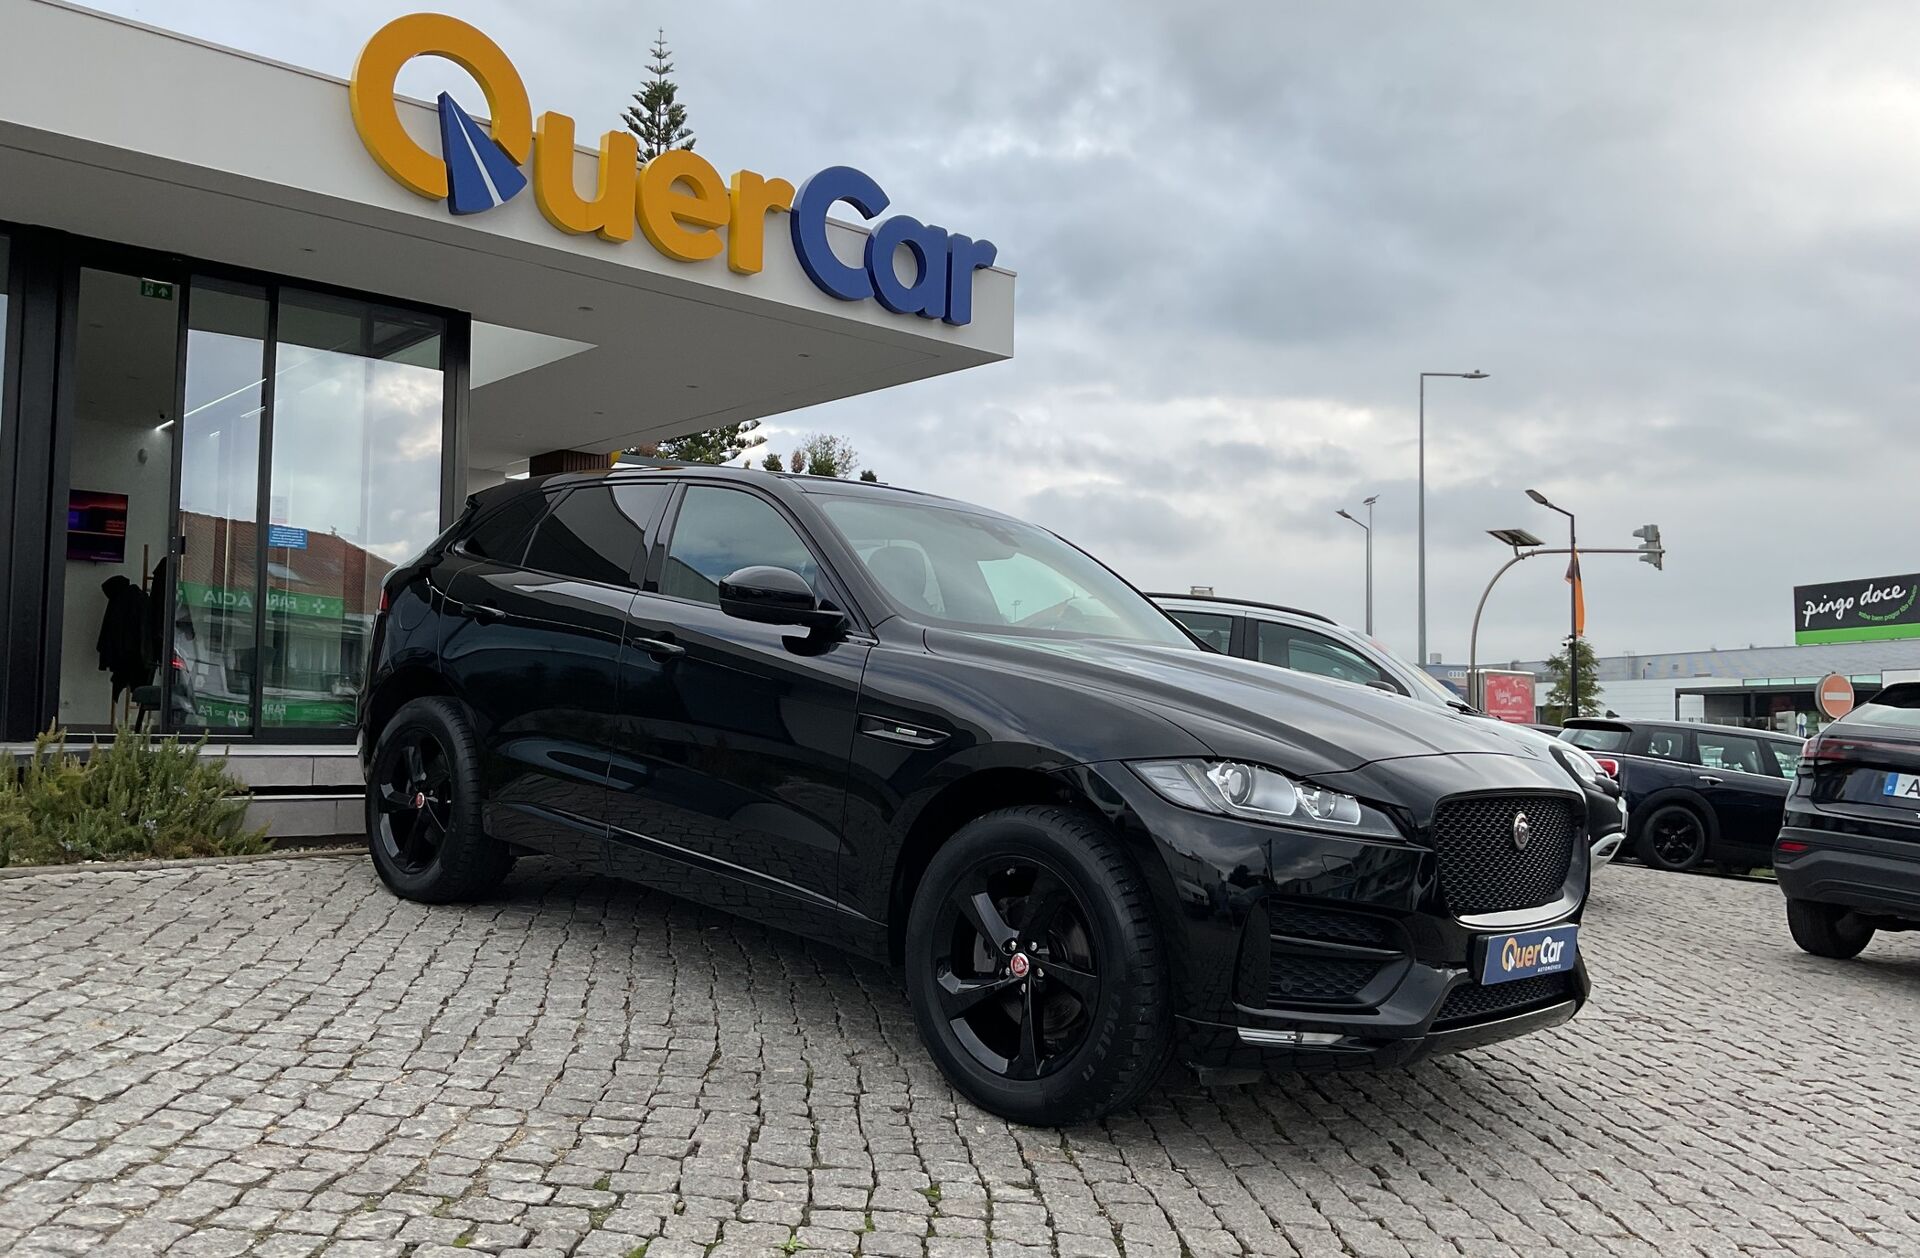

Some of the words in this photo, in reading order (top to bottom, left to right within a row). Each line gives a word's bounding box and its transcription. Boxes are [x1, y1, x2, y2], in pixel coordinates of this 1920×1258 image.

[351, 12, 997, 325] QuerCar
[1803, 594, 1854, 627] pingo
[1860, 584, 1906, 606] doce
[1502, 936, 1564, 972] QuerCar
